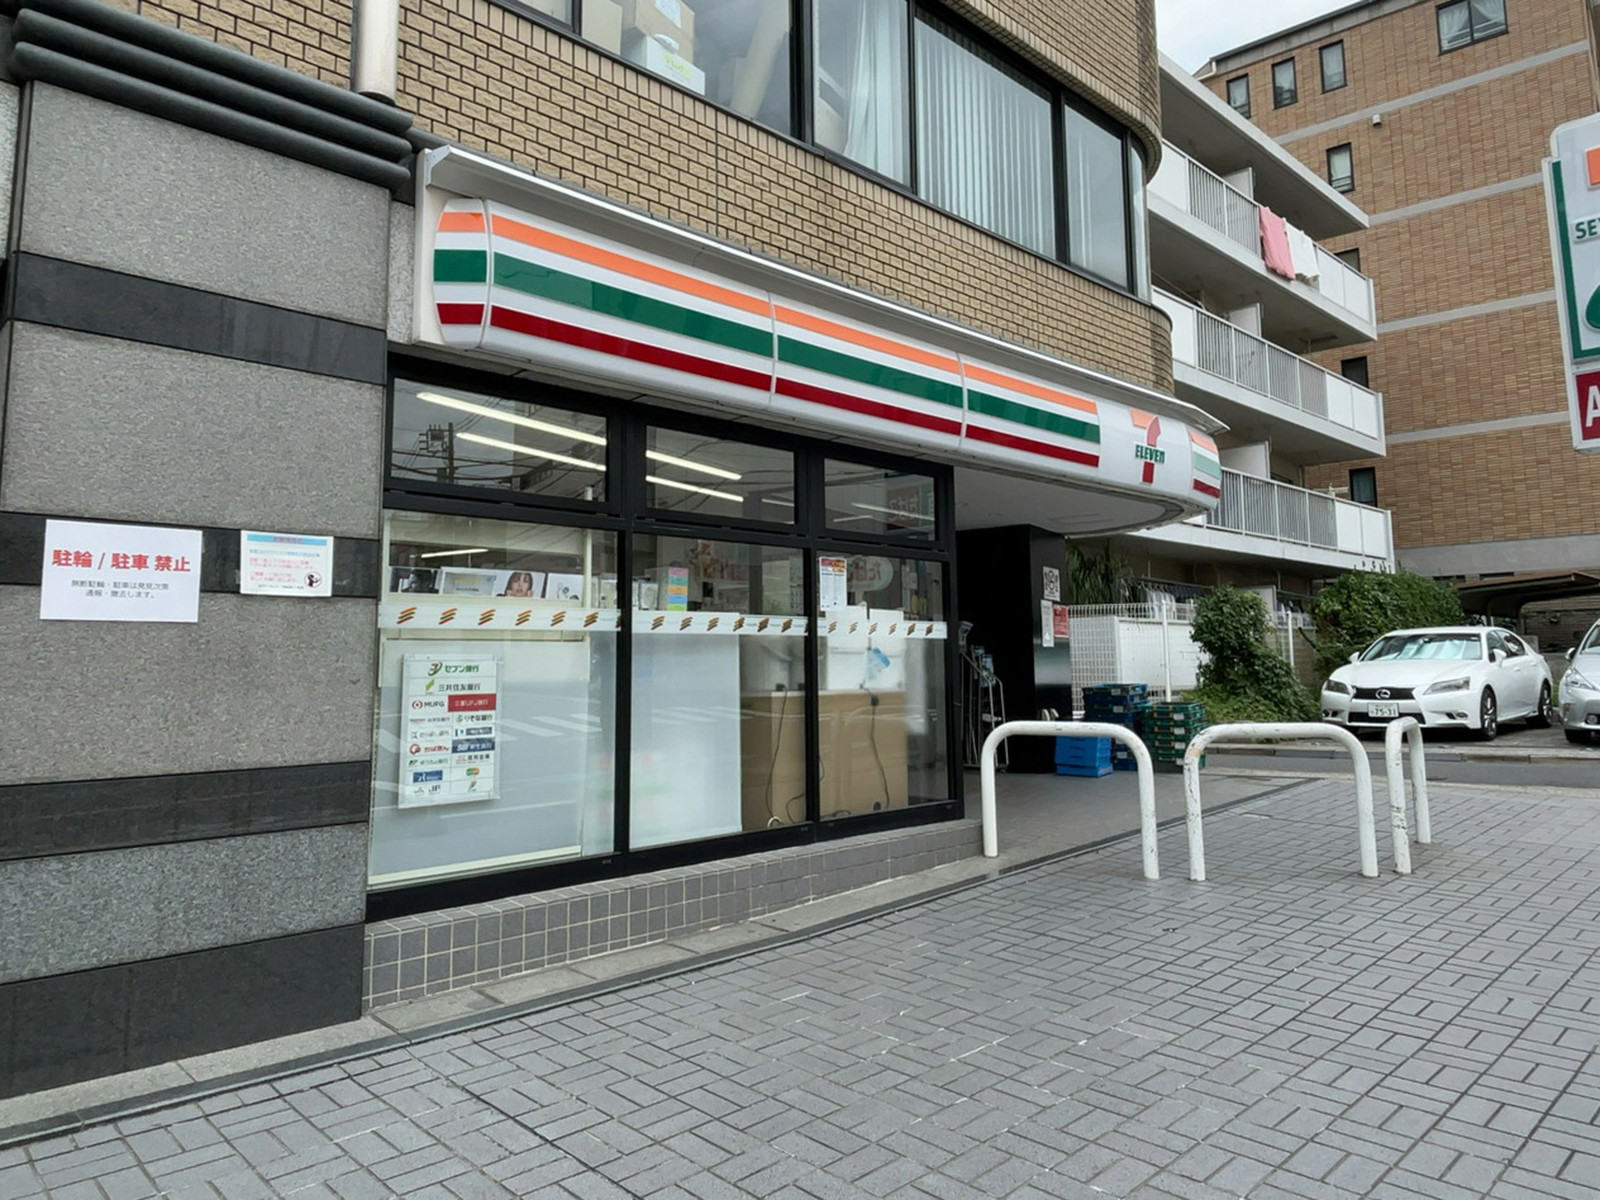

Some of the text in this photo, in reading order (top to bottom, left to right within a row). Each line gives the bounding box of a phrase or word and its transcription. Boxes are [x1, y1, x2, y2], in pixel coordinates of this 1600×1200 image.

[1575, 217, 1600, 239] SE
[52, 549, 191, 572] 駐輪 / 駐車 禁止
[444, 664, 479, 673] セブン銀行
[438, 682, 481, 692] 三井住友銀行
